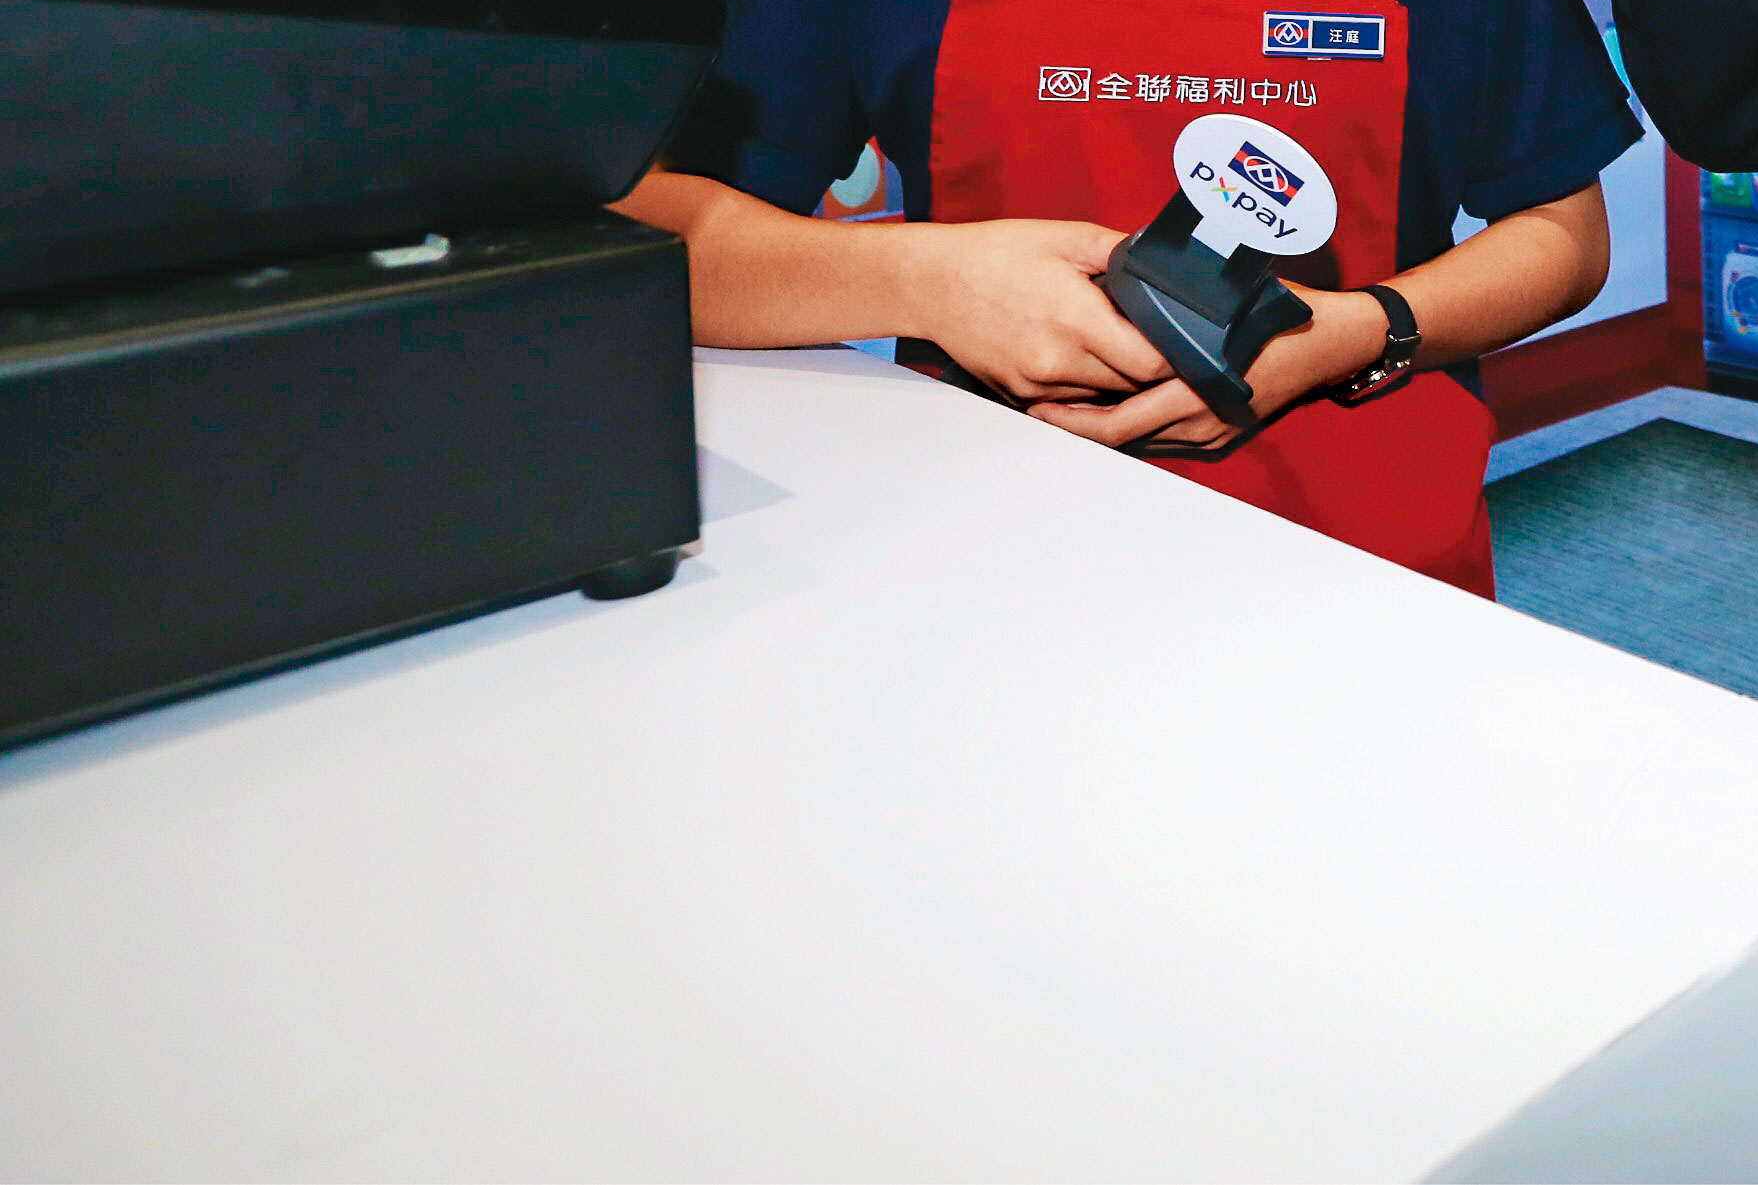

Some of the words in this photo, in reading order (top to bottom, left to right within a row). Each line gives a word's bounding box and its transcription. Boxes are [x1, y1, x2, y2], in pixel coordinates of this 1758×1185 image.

[1328, 29, 1360, 44] 汪庭
[1096, 72, 1318, 108] 全聯福利中心
[1188, 161, 1298, 239] pxpay
